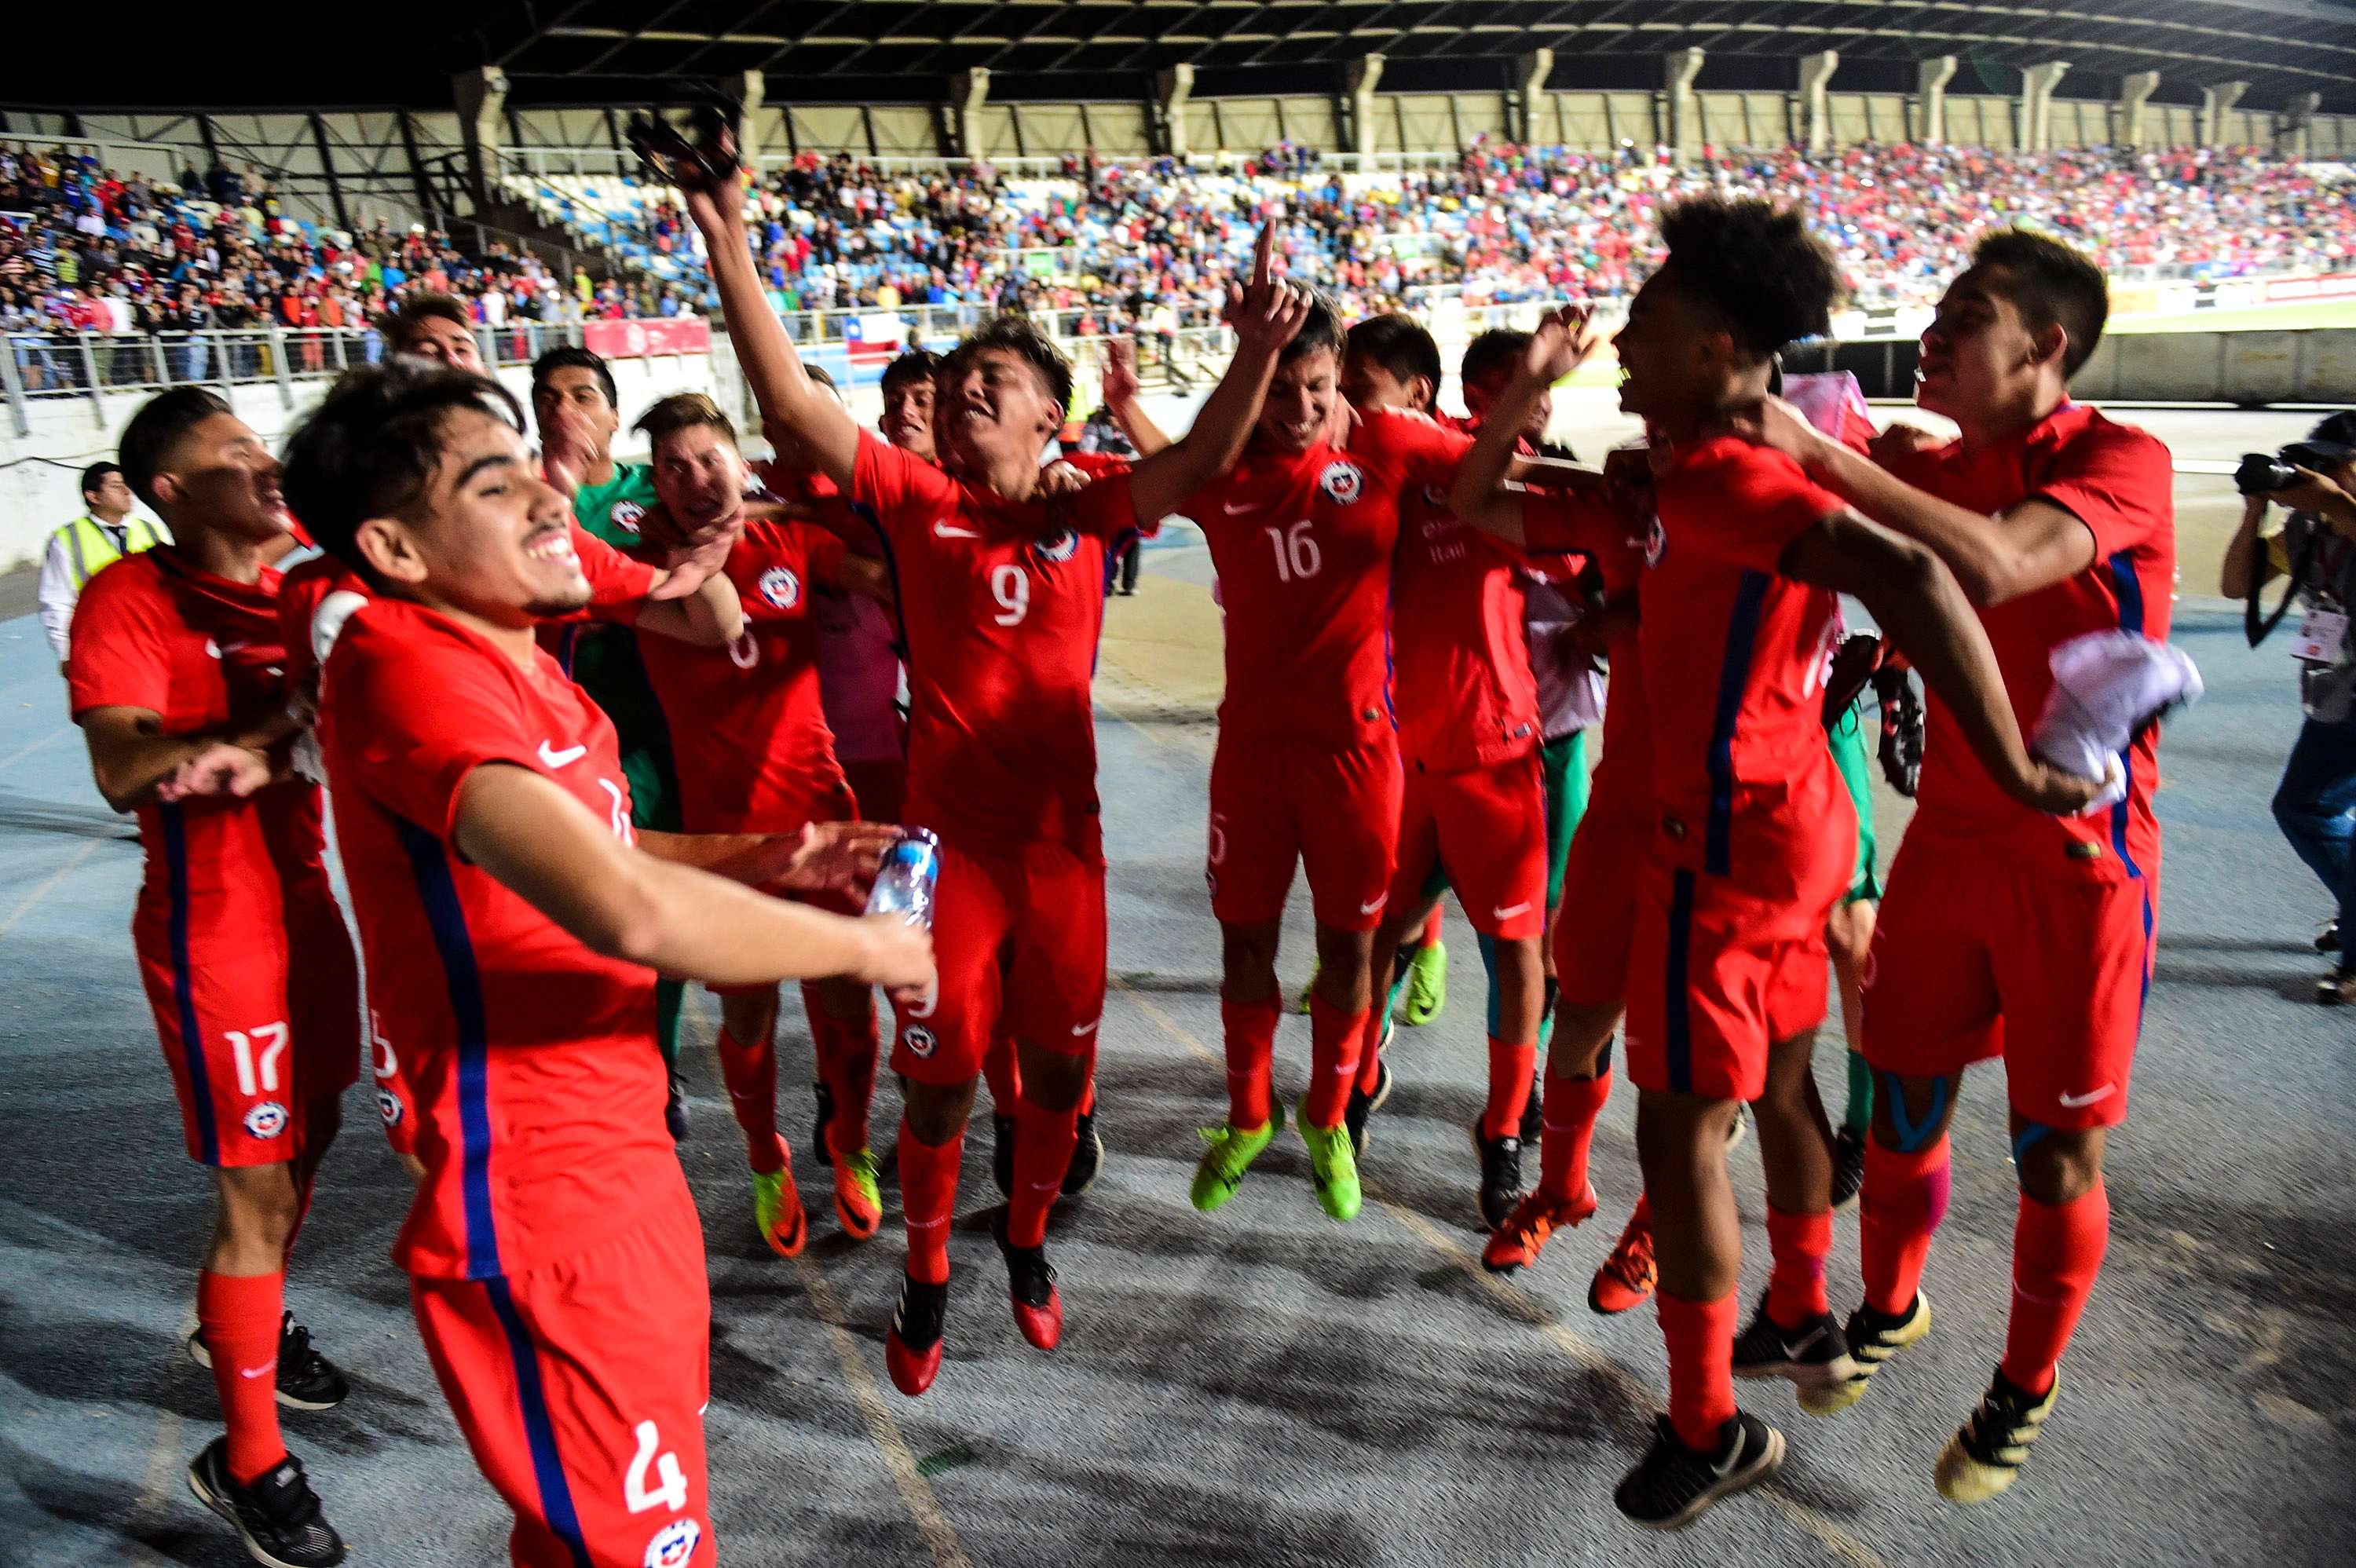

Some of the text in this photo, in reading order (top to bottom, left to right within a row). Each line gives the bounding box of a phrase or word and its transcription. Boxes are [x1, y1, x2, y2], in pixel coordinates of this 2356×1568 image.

[1264, 519, 1321, 583] 16
[991, 564, 1030, 627] 9
[224, 1021, 289, 1097] 17
[624, 1420, 688, 1515] 4
